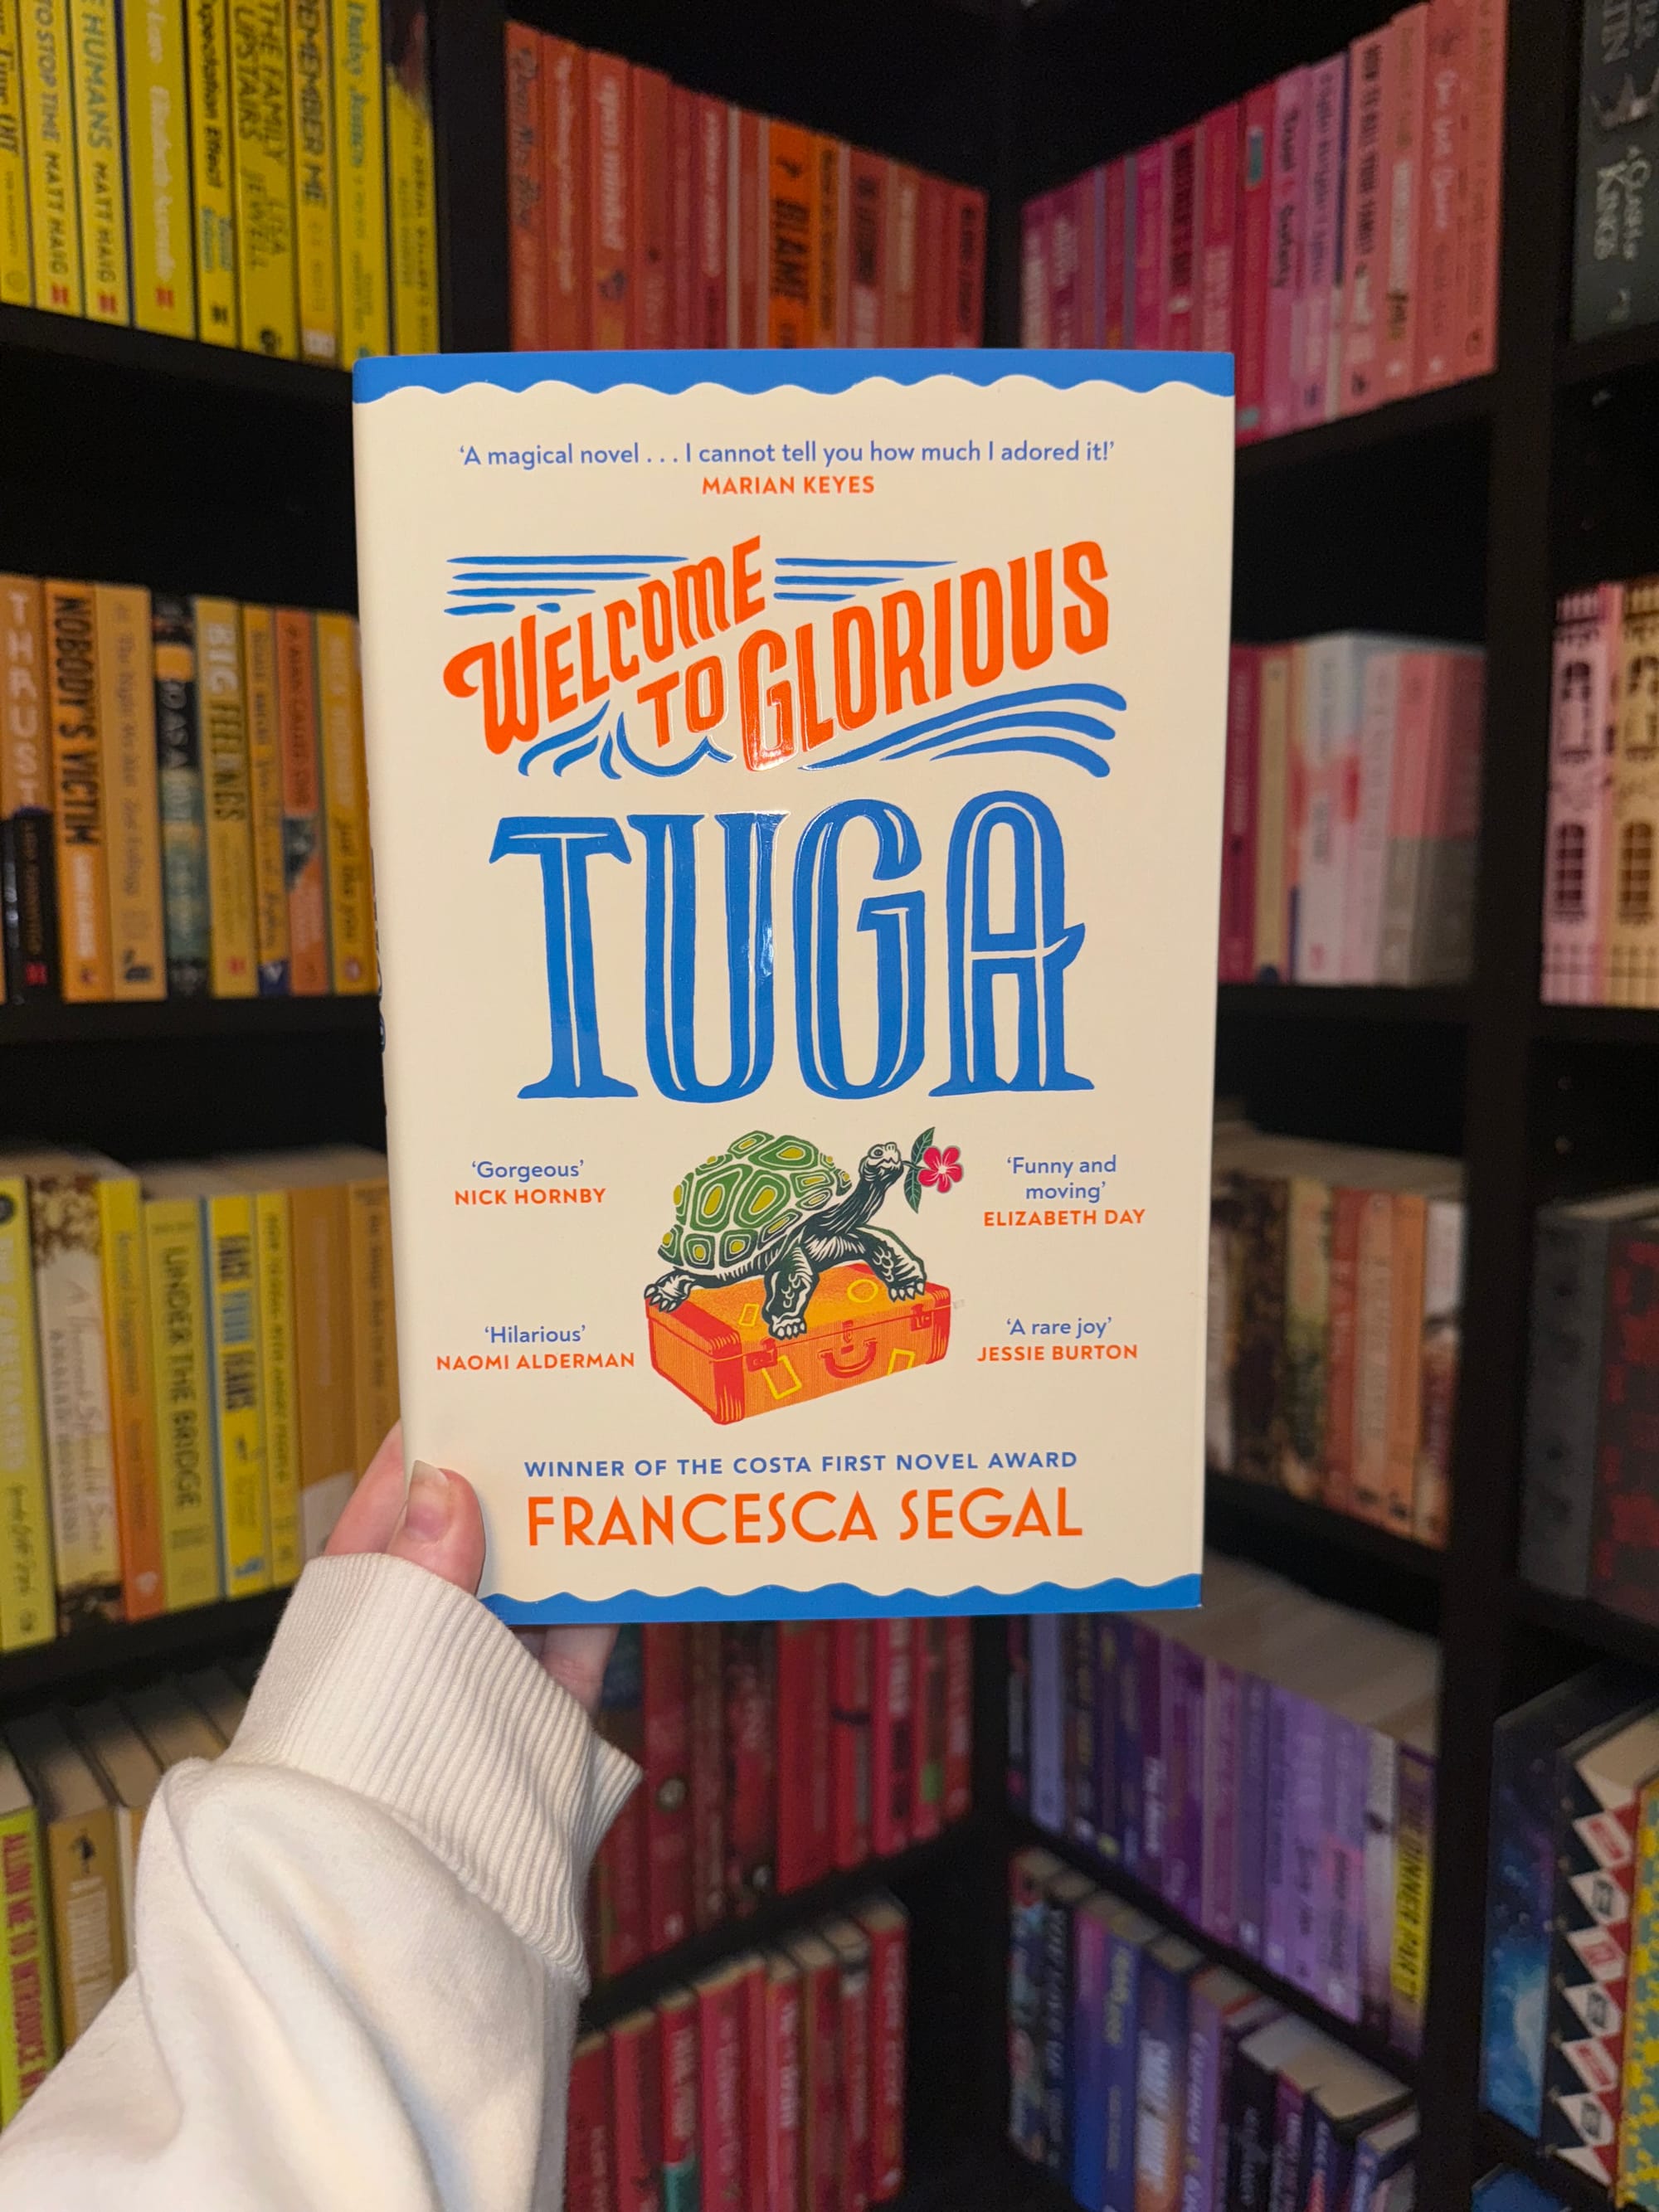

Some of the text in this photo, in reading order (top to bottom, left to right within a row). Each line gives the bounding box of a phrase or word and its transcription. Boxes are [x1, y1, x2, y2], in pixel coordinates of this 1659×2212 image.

[36, 30, 56, 87] STOP
[81, 13, 112, 150] HUMANS
[41, 93, 61, 143] TIME
[44, 152, 68, 275] MATT HAIG
[92, 162, 115, 283] MATT HAIG
[460, 447, 480, 464] ‘A
[488, 444, 572, 470] magical
[581, 443, 638, 463] novel
[686, 445, 690, 461] I
[699, 445, 773, 462] cannot
[782, 441, 815, 462] tell
[824, 449, 862, 466] you
[871, 442, 914, 461] how
[922, 441, 980, 460] much
[989, 442, 993, 459] I
[1002, 441, 1078, 460] adored
[703, 475, 875, 495] MARIAN KEYES
[54, 596, 95, 738] NOBODY'S
[206, 621, 239, 694] BIG
[443, 535, 762, 754] WELCOME
[637, 541, 1109, 771] TO GLORIOUS
[62, 751, 100, 846] VICTIM
[489, 790, 1095, 1105] TUGA
[471, 1159, 585, 1184] ‘Gorgeous’
[1007, 1155, 1117, 1179] ‘Funny and
[455, 1188, 606, 1206] NICK HORNBY
[984, 1209, 1146, 1228] ELIZABETH DAY
[1026, 1182, 1107, 1206] moving’
[484, 1324, 586, 1344] ‘Hilarious’
[1006, 1317, 1113, 1339] ‘A rare joy’
[164, 1246, 202, 1510] UNDER THE BRIDGE
[436, 1354, 635, 1371] NAOMI ALDERMAN
[977, 1344, 1138, 1363] JESSIE BURTON
[524, 1452, 1077, 1478] WINNER OF THE COSTA FIRST NOVEL AWARD
[528, 1487, 1082, 1547] FRANCESCA SEGAL
